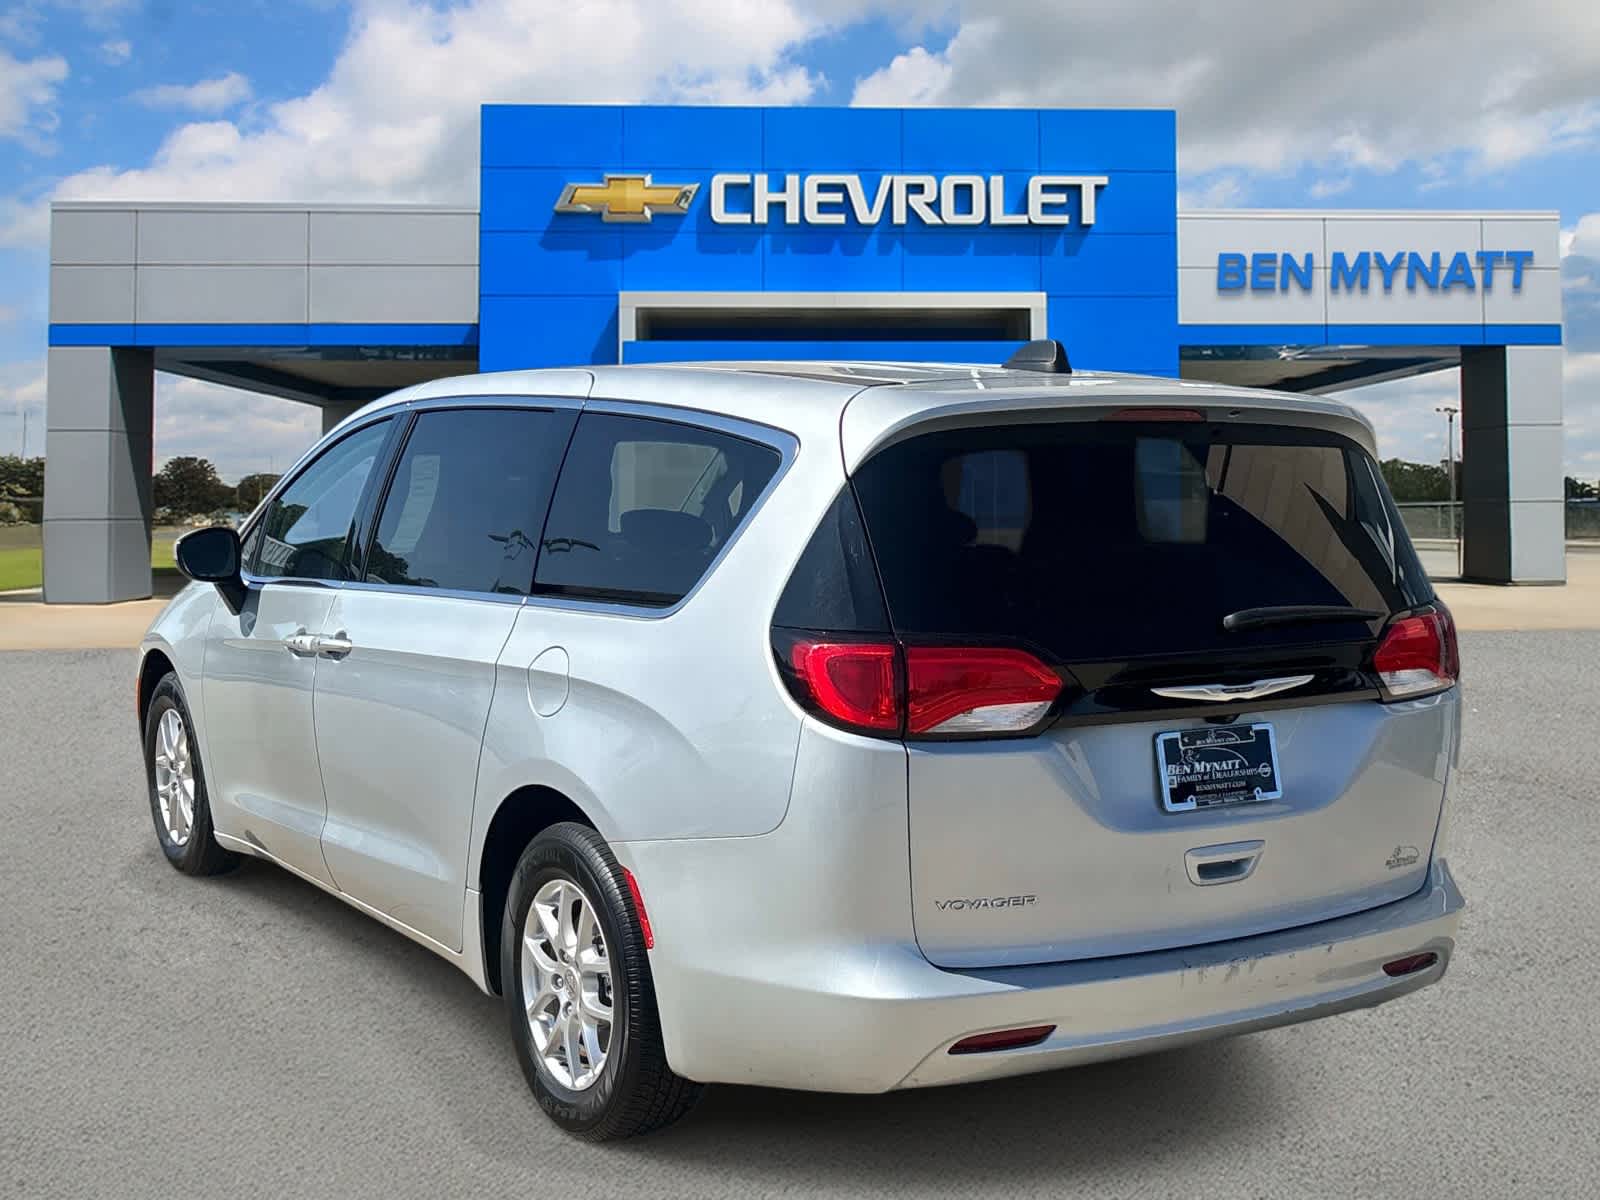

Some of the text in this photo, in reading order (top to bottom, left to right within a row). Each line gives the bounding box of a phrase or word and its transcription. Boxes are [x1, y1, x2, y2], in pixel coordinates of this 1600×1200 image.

[710, 173, 1109, 226] CHEVROLET
[1217, 250, 1534, 291] BEN MYNATT
[1167, 763, 1192, 776] BEN
[1194, 759, 1242, 774] MYNATT
[1177, 773, 1203, 784] FAMILY
[1211, 768, 1258, 780] DEALERSHIPS
[935, 895, 1037, 911] VOYAGER
